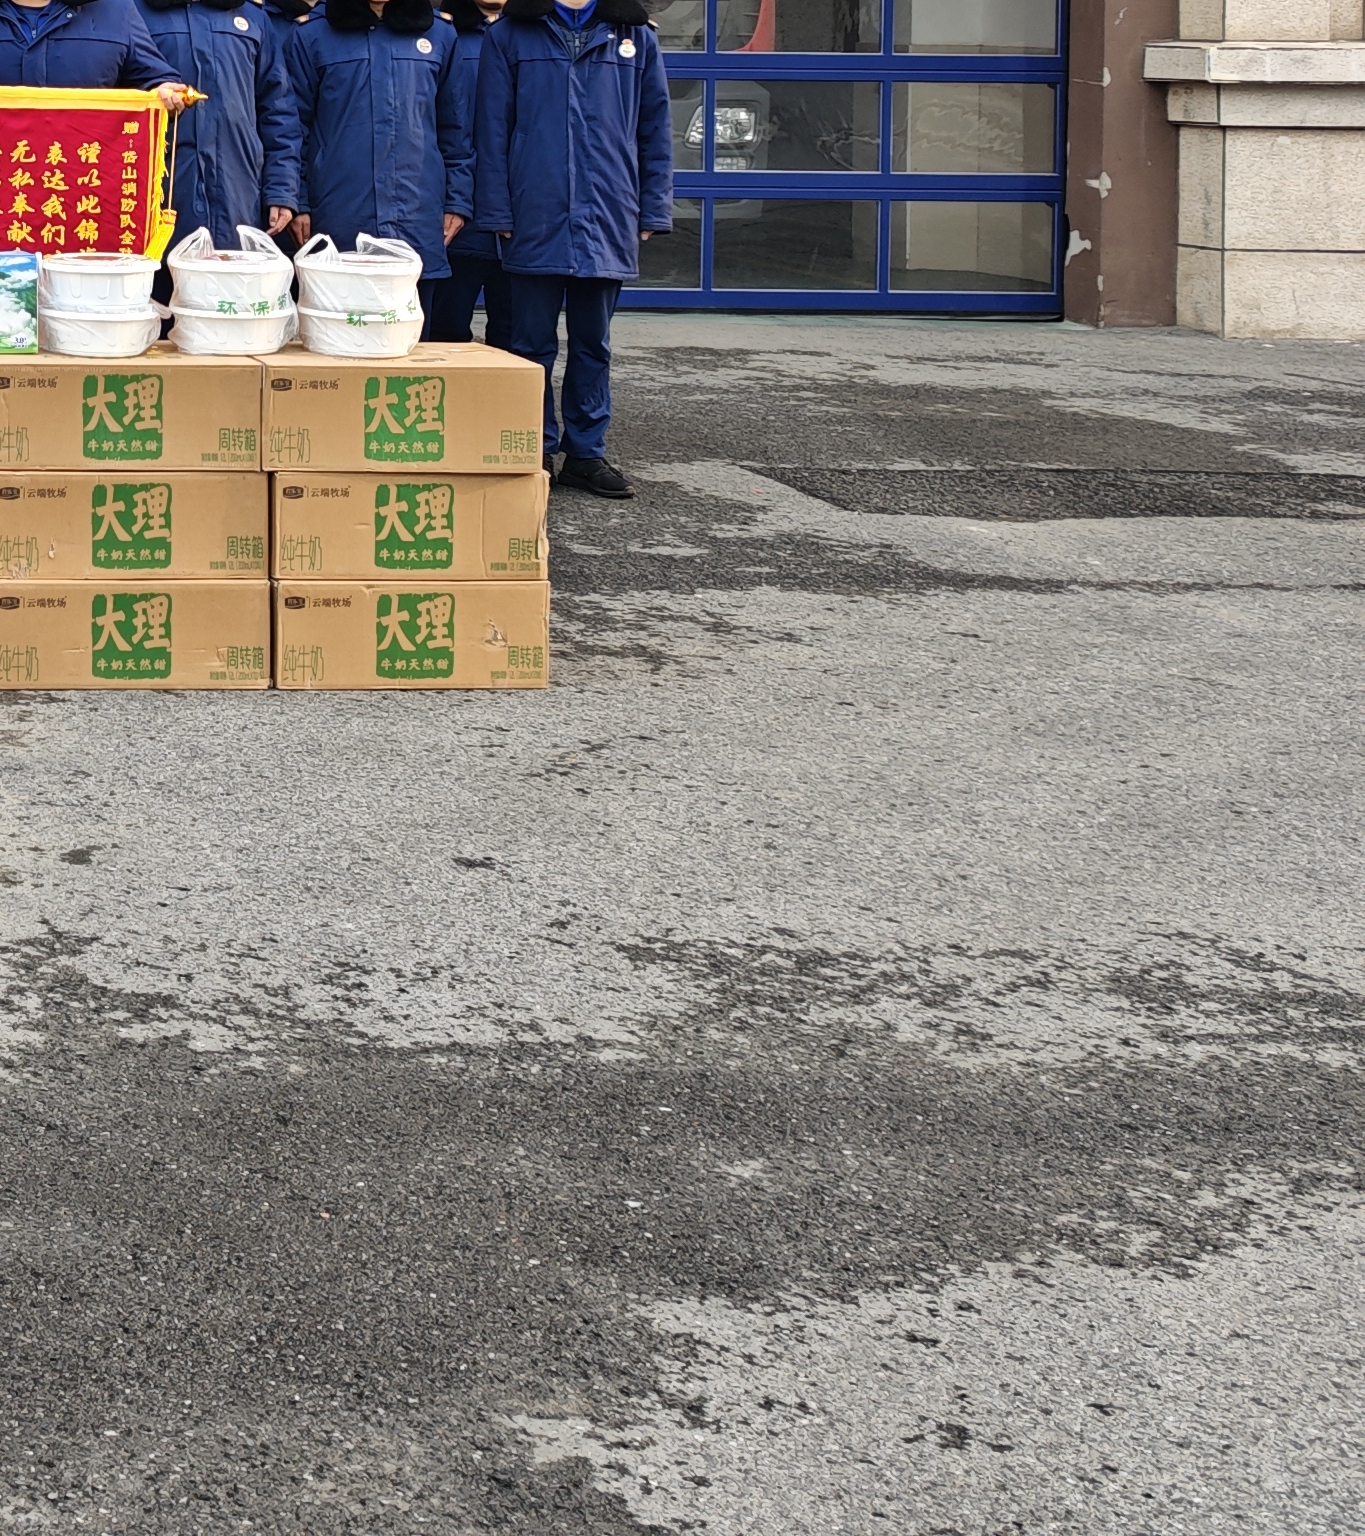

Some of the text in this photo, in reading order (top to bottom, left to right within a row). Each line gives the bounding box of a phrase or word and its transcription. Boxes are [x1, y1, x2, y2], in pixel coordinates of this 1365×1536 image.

[6, 140, 37, 252] 无私奉献
[40, 141, 69, 258] 表达我们
[18, 376, 58, 388] 云端牧场
[299, 378, 339, 390] 云端牧场
[85, 374, 163, 432] 大理
[366, 376, 444, 434] 大理
[88, 438, 159, 452] 牛奶天然甜
[218, 427, 256, 452] 周转箱
[369, 440, 440, 454] 牛奶天然甜
[499, 429, 537, 454] 周转箱
[27, 485, 67, 497] 云端牧场
[309, 485, 349, 497] 云端牧场
[94, 483, 172, 541] 大理
[376, 483, 454, 541] 大理
[97, 547, 168, 561] 牛奶天然甜
[227, 536, 265, 561] 周转箱
[379, 547, 450, 561] 牛奶天然甜
[27, 595, 67, 607] 云端牧场
[311, 595, 351, 607] 云端牧场
[94, 593, 172, 651] 大理
[378, 593, 456, 651] 大理
[97, 657, 168, 671] 牛奶天然甜
[227, 646, 265, 671] 周转箱
[381, 657, 452, 671] 牛奶天然甜
[511, 646, 549, 671] 周转箱
